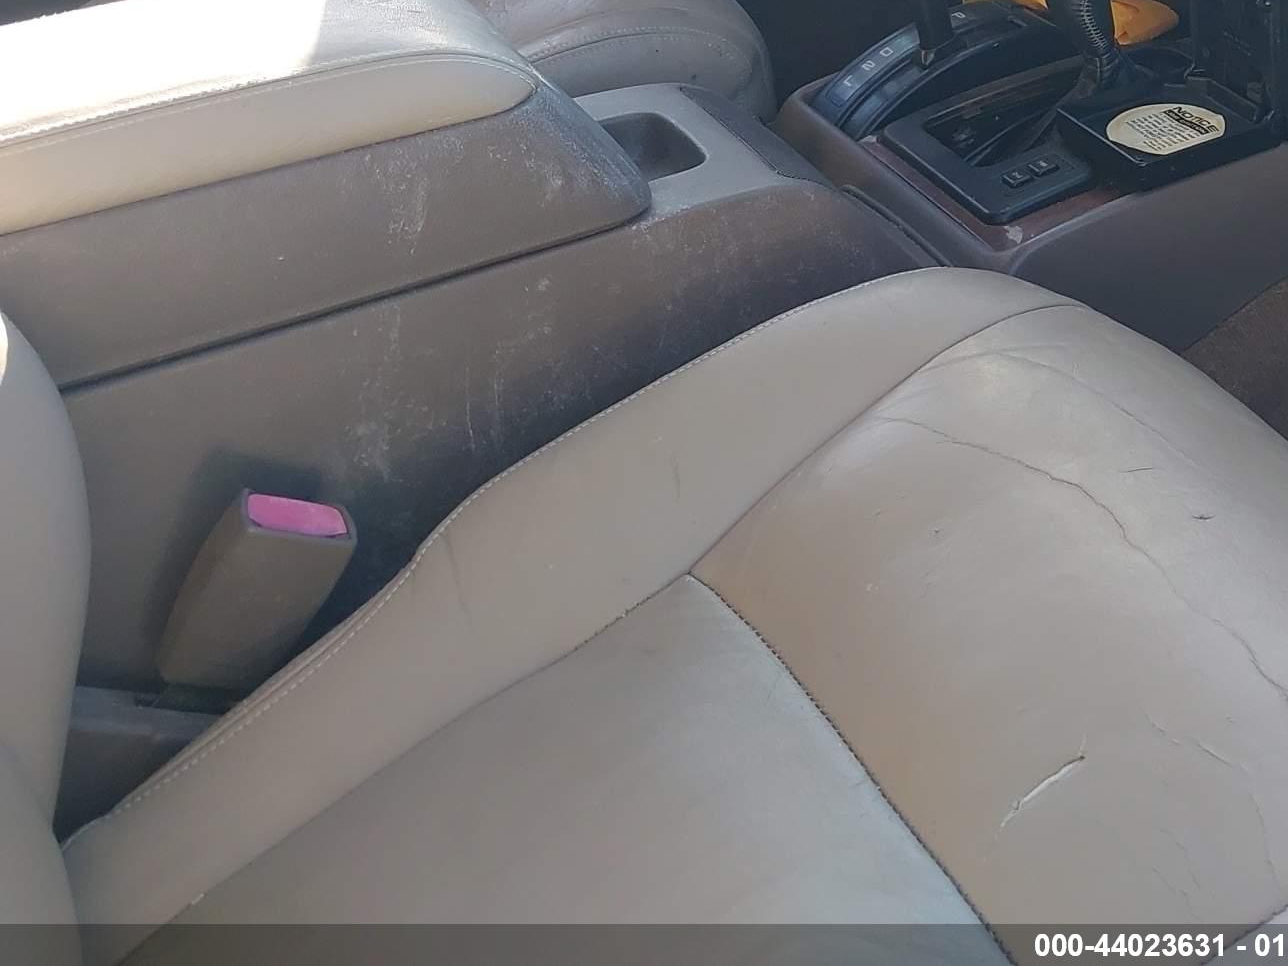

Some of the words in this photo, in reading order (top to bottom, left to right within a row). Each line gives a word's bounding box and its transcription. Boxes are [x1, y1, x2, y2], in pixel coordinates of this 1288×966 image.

[951, 11, 966, 19] P
[843, 75, 853, 86] L
[1173, 106, 1220, 133] NOTICE
